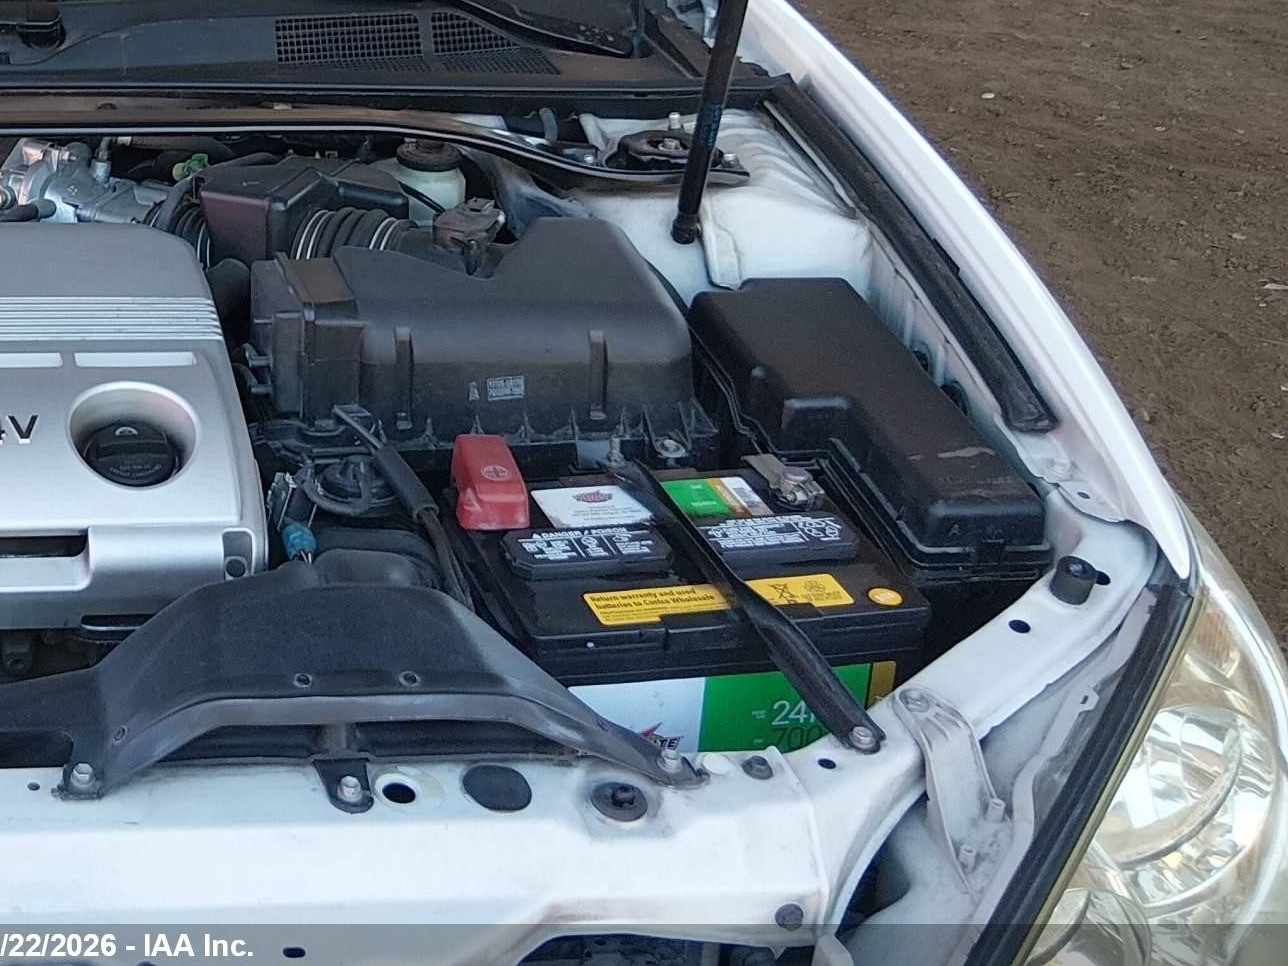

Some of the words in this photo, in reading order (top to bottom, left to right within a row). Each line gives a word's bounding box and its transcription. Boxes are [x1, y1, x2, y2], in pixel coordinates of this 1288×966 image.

[541, 529, 582, 539] DANGER
[591, 526, 627, 535] POISON
[590, 594, 620, 603] Return
[620, 591, 657, 602] warranty
[658, 589, 674, 597] and
[675, 587, 696, 595] used
[595, 601, 633, 610] batteries
[671, 594, 715, 604] Wholesale
